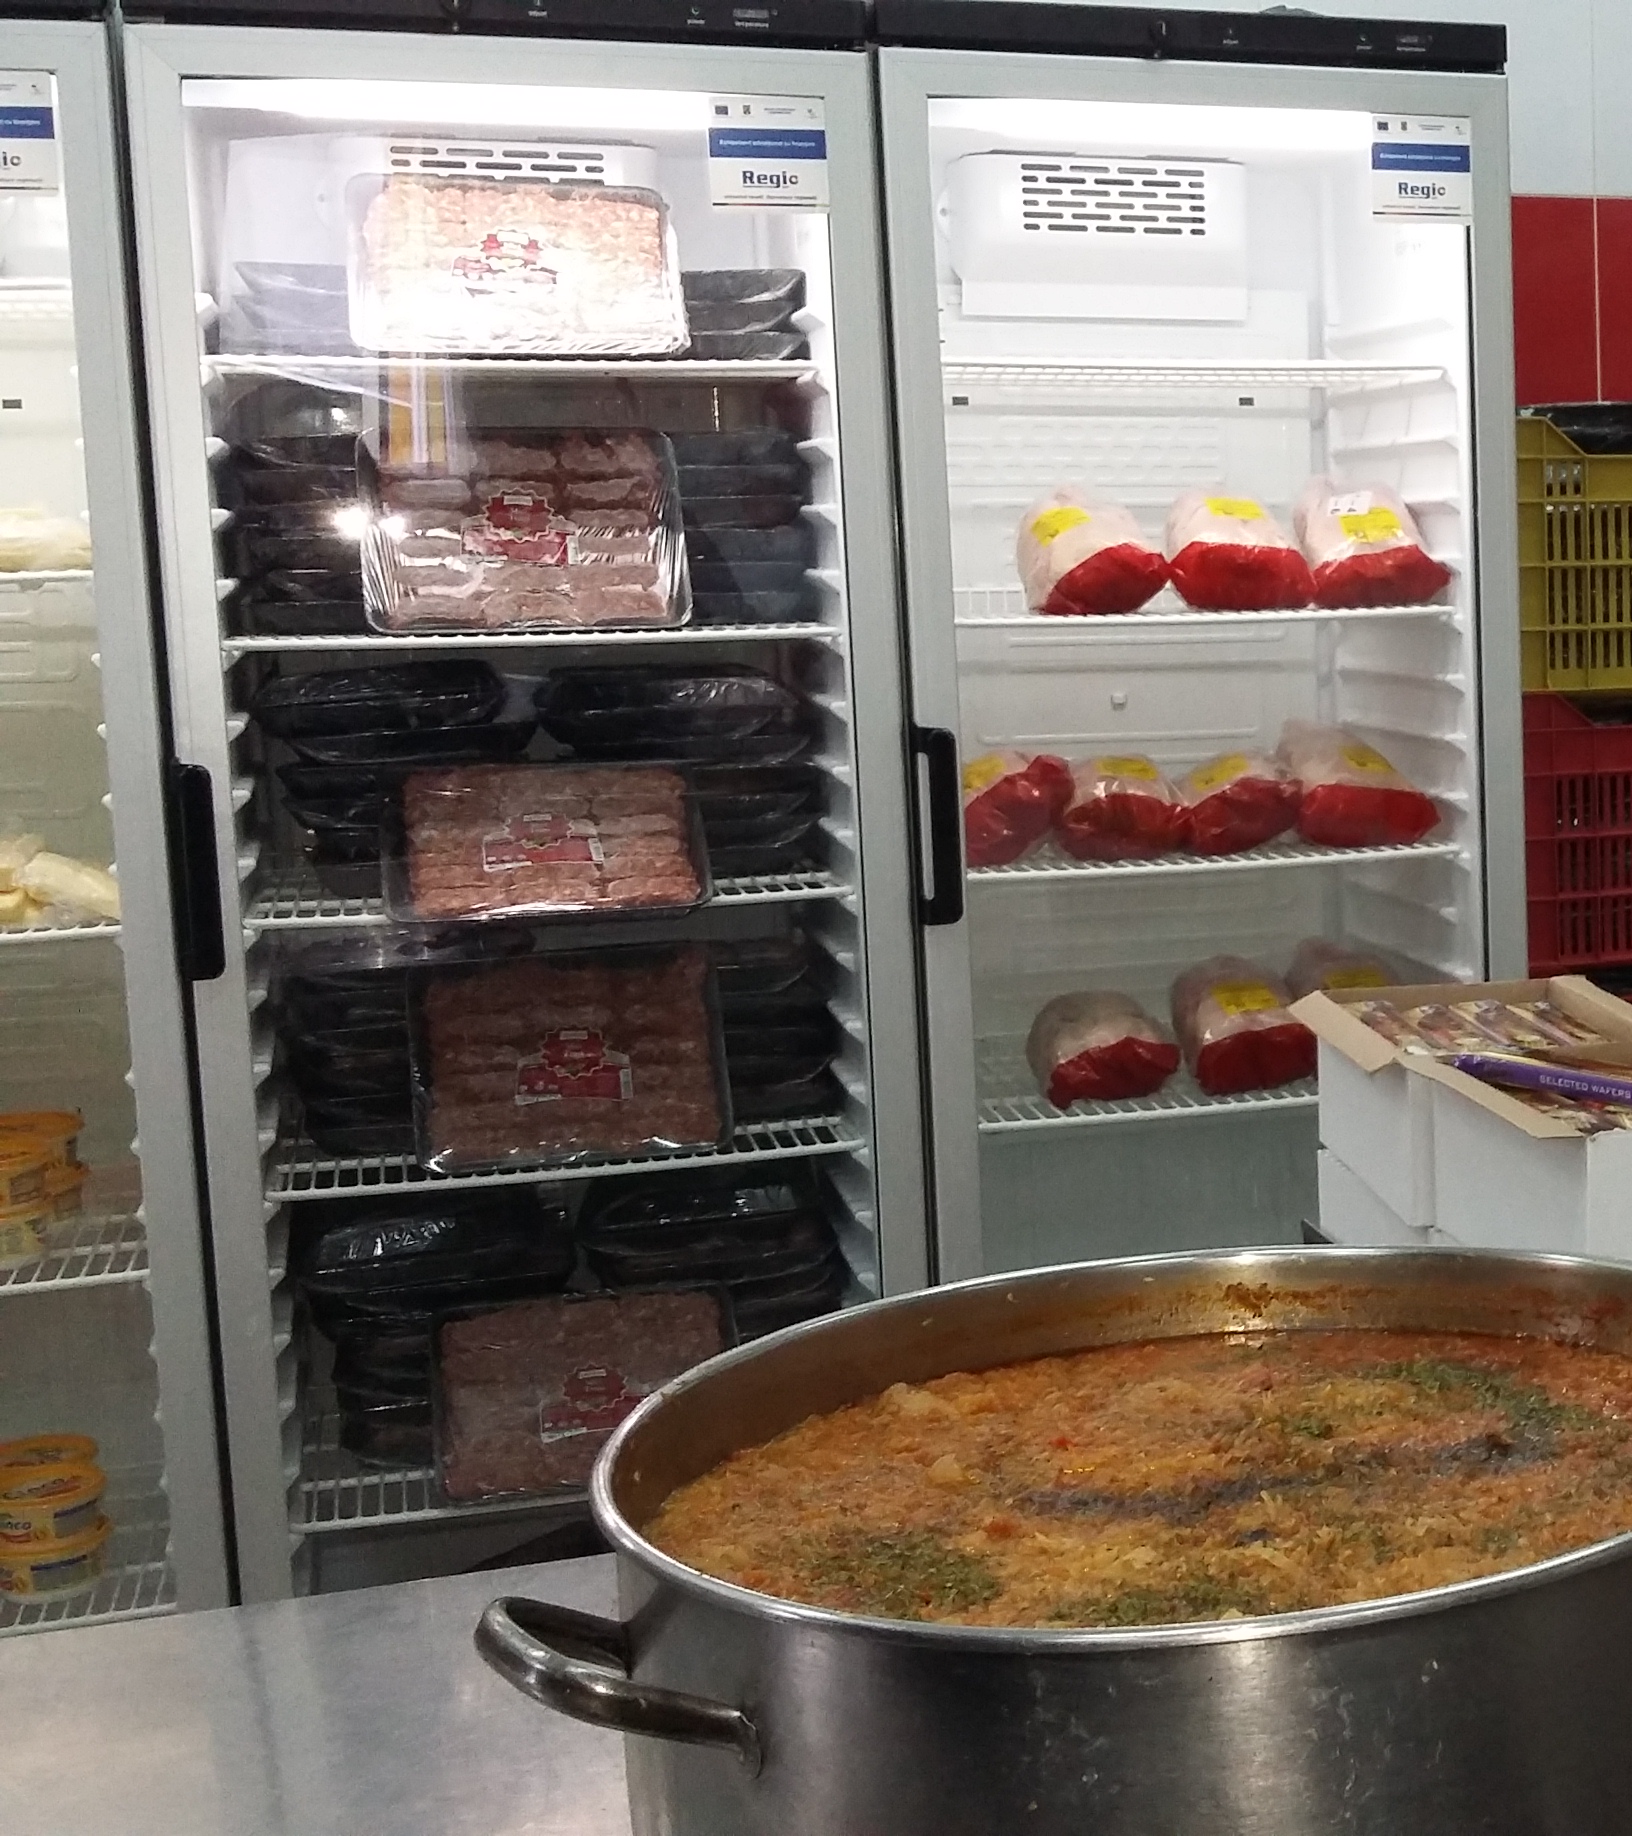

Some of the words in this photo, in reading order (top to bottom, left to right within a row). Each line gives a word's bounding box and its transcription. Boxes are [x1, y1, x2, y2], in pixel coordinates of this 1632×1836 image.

[742, 170, 799, 188] Regic
[1398, 182, 1446, 199] Regic
[1539, 1075, 1588, 1092] SELECTED
[1592, 1085, 1632, 1099] WAFERS
